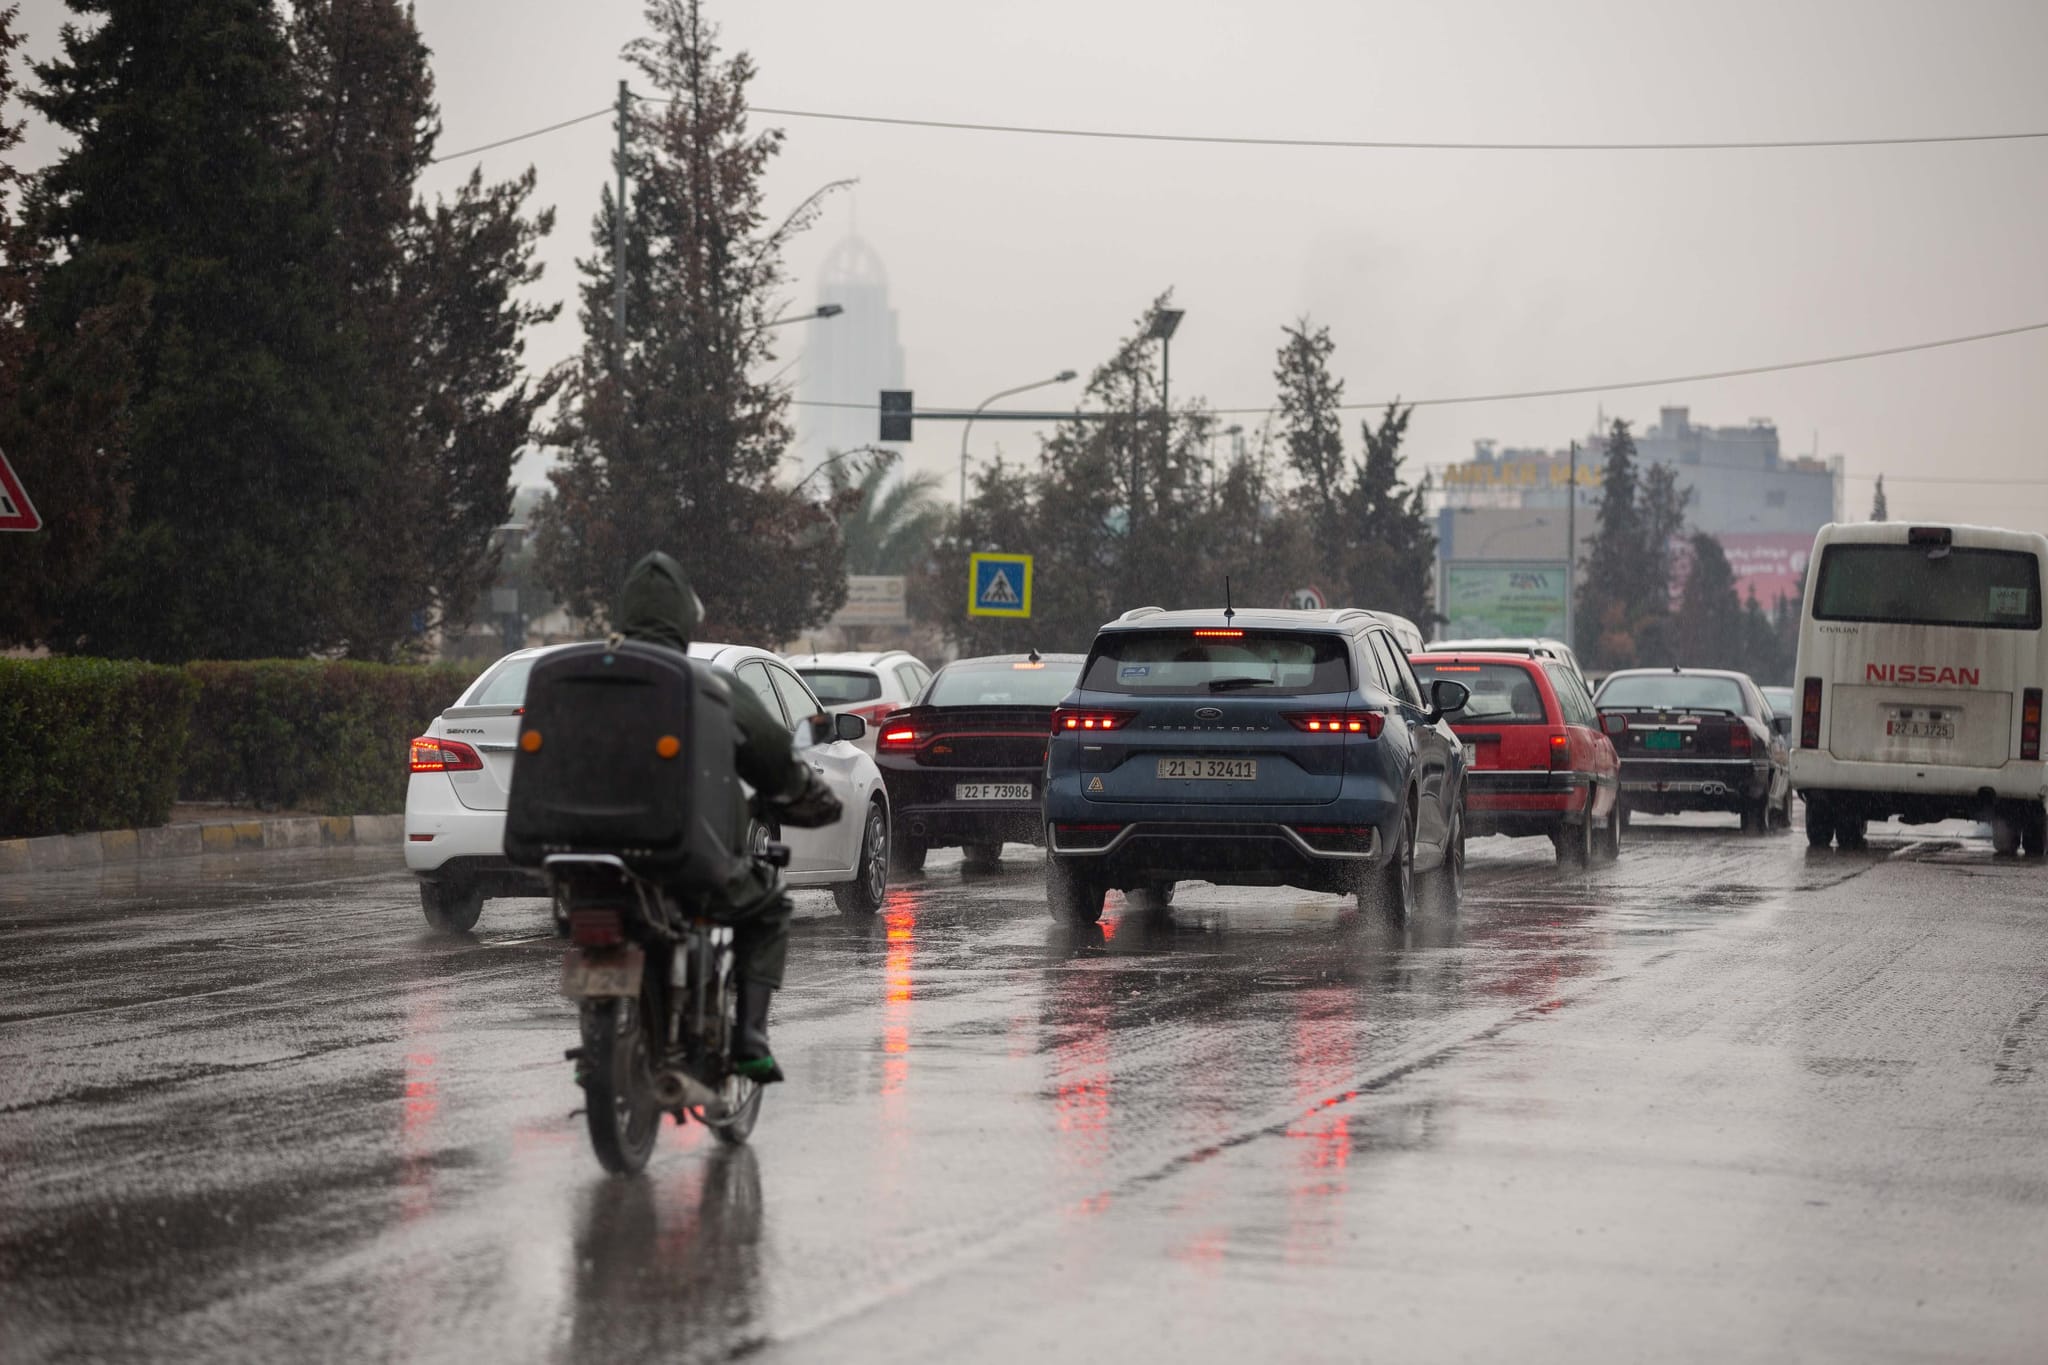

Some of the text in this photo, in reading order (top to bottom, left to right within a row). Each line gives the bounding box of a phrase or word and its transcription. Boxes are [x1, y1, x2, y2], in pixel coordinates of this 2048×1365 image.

[1866, 663, 1980, 686] NISSAN
[1894, 722, 1907, 734] 22
[1169, 760, 1252, 778] 21 J 32411
[964, 785, 1029, 798] 22 F 73986
